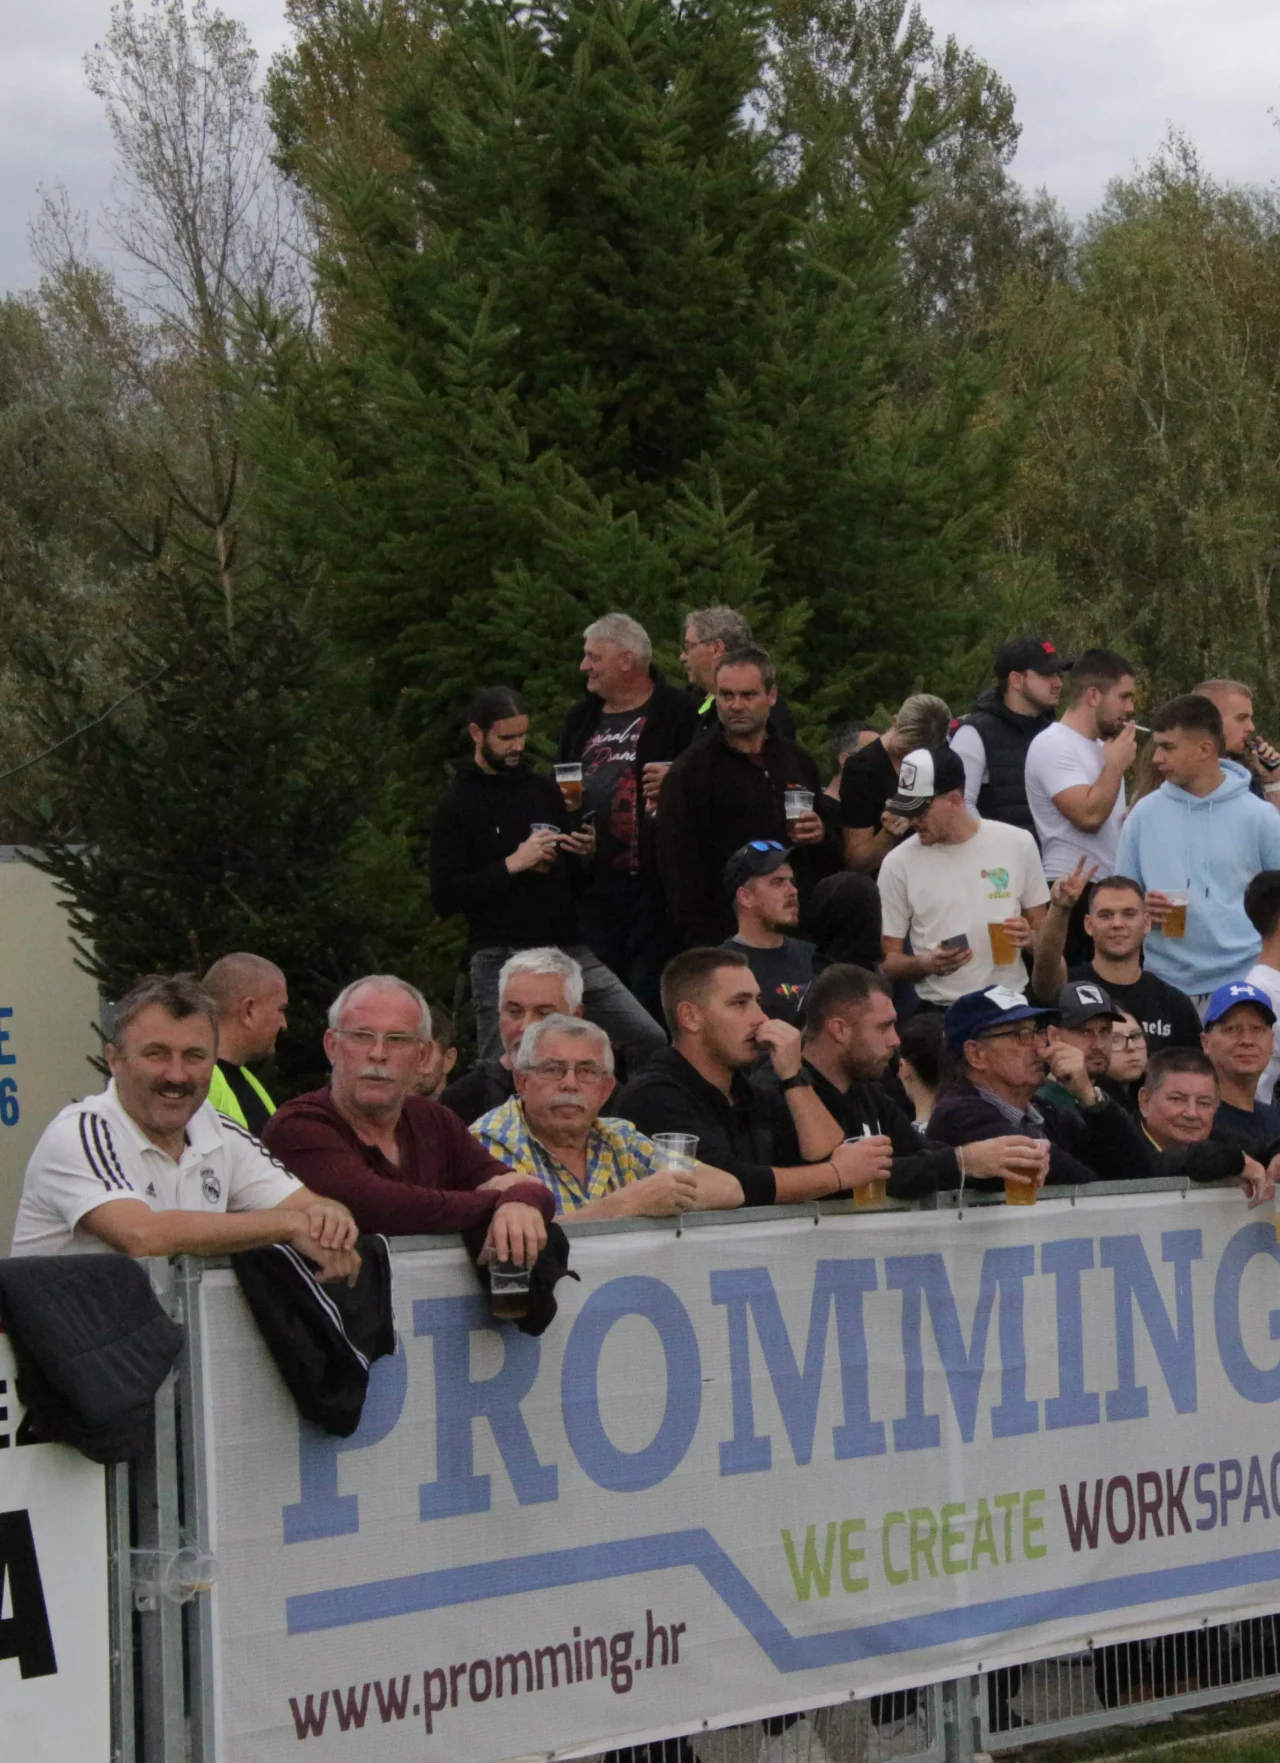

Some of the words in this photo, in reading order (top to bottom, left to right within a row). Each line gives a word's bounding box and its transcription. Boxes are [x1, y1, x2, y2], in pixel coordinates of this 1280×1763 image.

[781, 1518, 869, 1602] WE
[882, 1489, 1047, 1584] CREATE
[289, 1609, 687, 1740] www.promming.hr
